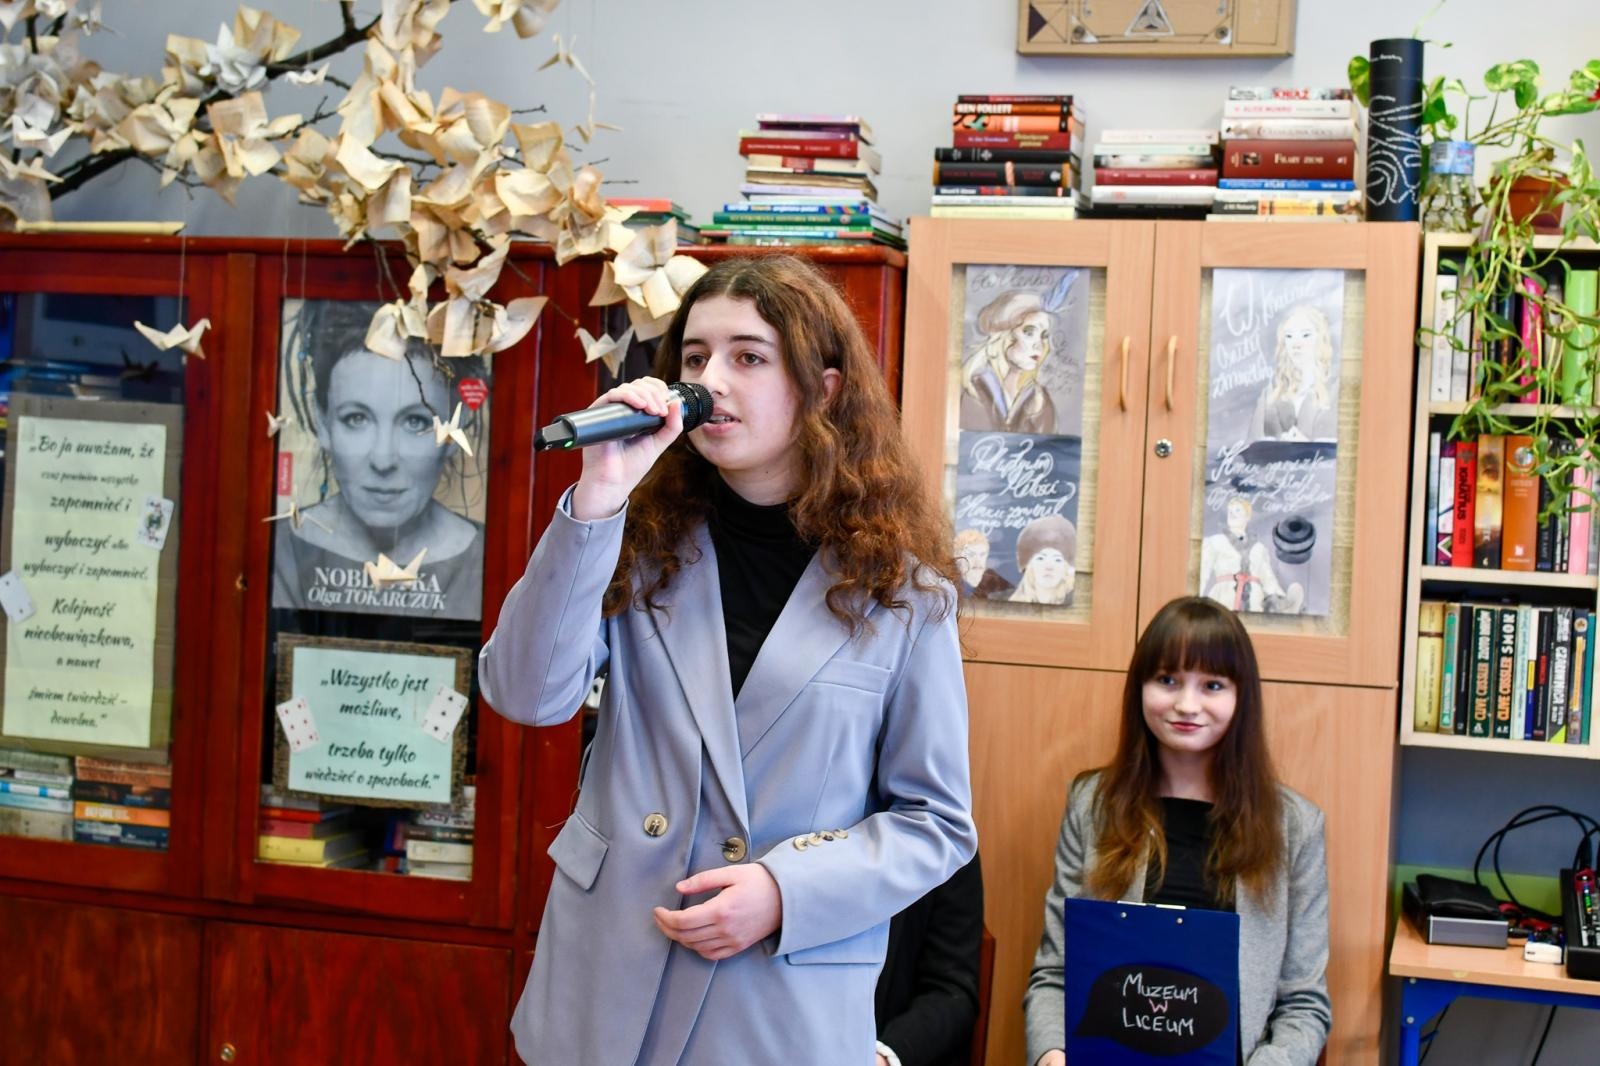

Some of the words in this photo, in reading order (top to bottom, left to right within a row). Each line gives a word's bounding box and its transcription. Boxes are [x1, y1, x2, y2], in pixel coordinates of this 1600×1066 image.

[957, 103, 976, 114] KEN
[977, 103, 1013, 114] FOLLETT
[57, 437, 72, 458] ja
[76, 441, 135, 458] uważam,
[139, 442, 155, 458] że
[50, 495, 123, 513] zapomnieć
[125, 499, 132, 512] i
[45, 530, 112, 554] wybaczyć
[23, 558, 78, 577] wybaczyć
[79, 562, 85, 575] i
[314, 566, 442, 593] NOBLKA
[52, 598, 117, 621] Kolejność
[307, 586, 342, 606] Olga
[344, 588, 447, 610] TOKARCZUK
[24, 624, 135, 650] nieobowiązkowa,
[1501, 613, 1516, 655] SMOK
[56, 657, 63, 665] a
[66, 656, 101, 669] nawet
[320, 668, 399, 693] „Wszystko
[400, 674, 430, 696] jest
[1476, 662, 1490, 696] CUSSLER
[1500, 656, 1513, 694] CUSSLER
[28, 685, 64, 700] śmiem
[67, 690, 119, 705] twierdzić
[339, 699, 402, 721] możliwe,
[1497, 694, 1511, 721] CLIVE
[328, 741, 375, 760] trzeba
[379, 743, 417, 768] tylko
[305, 766, 355, 783] wiedzieć
[357, 775, 365, 784] o
[1122, 972, 1198, 1004] MUZEUM
[1123, 1007, 1194, 1036] LICEUM
